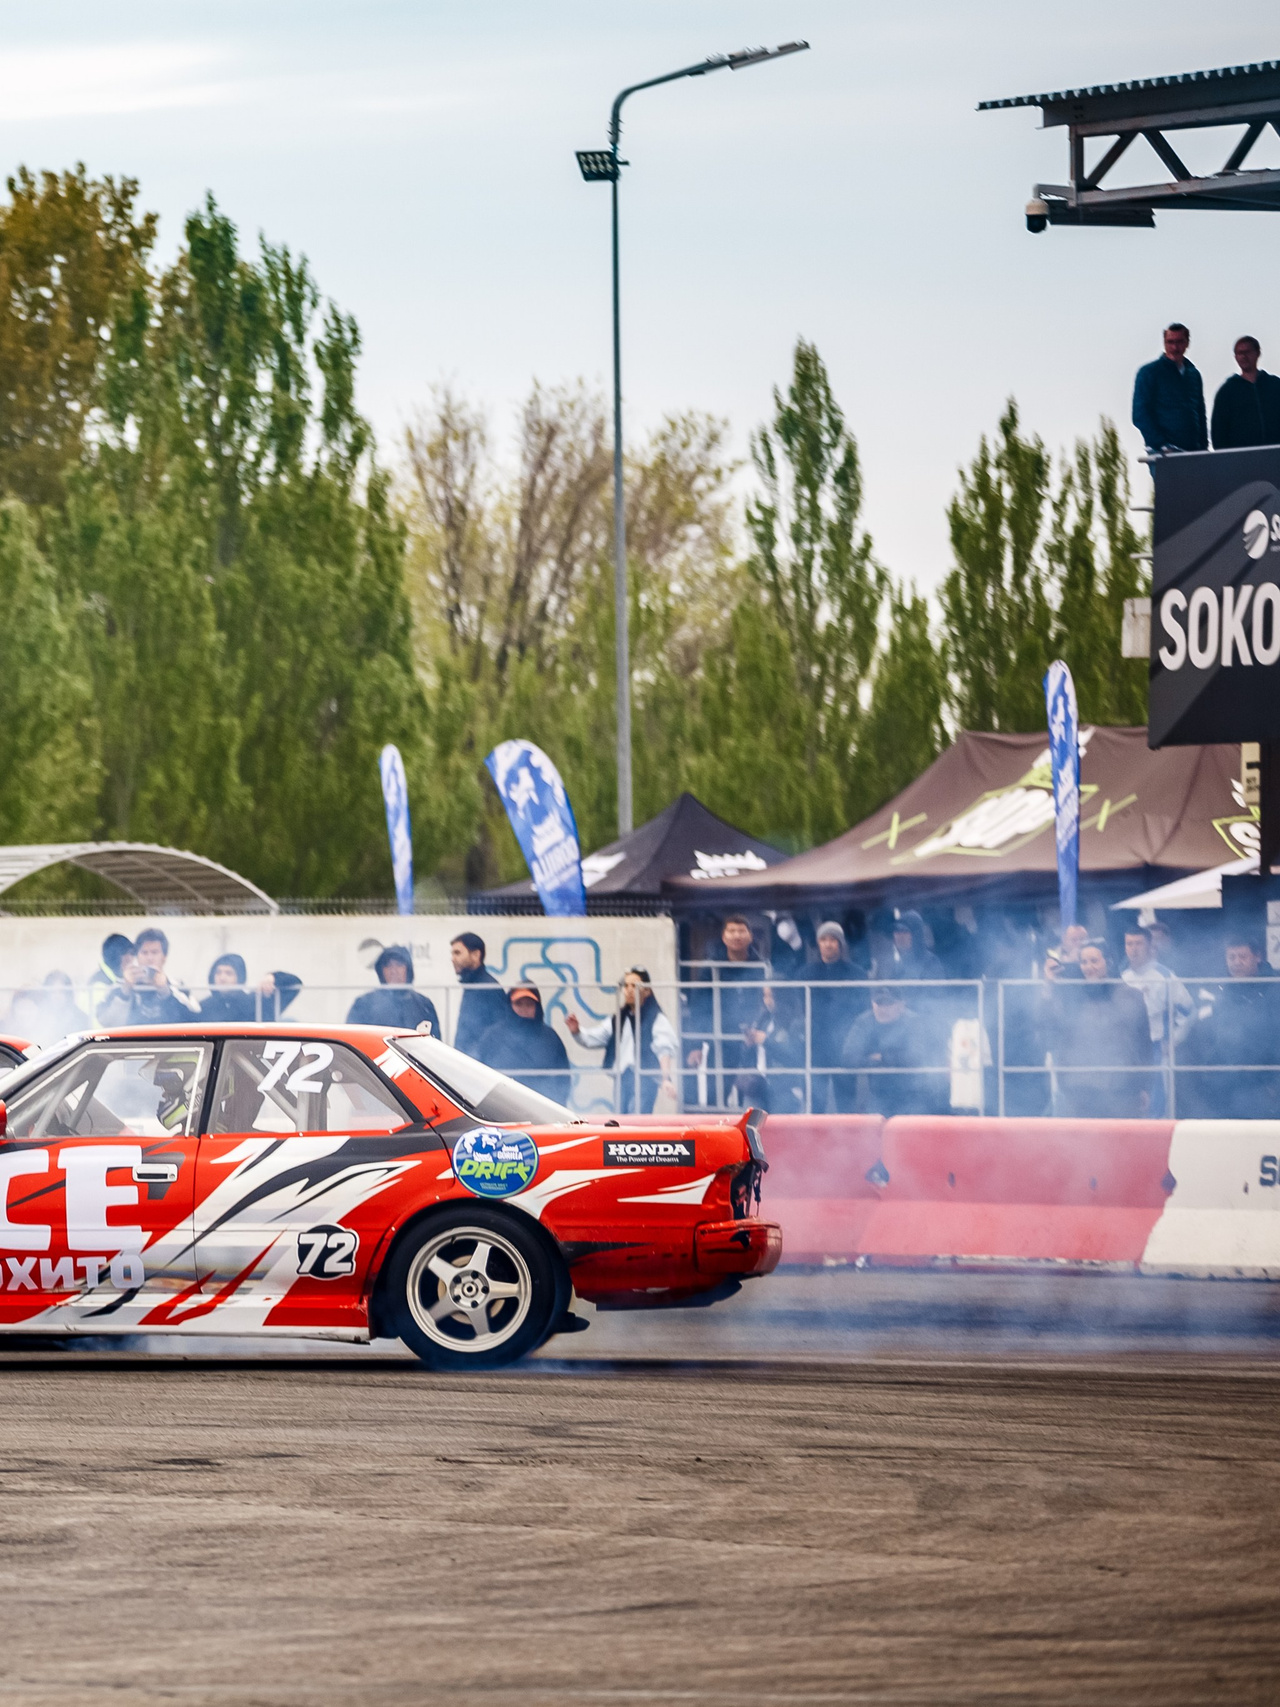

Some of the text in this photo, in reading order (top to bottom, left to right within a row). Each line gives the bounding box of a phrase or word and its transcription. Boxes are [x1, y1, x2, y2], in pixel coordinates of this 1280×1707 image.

[1158, 582, 1280, 671] SOKO
[257, 1041, 333, 1093] 72
[608, 1143, 691, 1156] HONDA
[1260, 1155, 1280, 1187] S
[299, 1232, 356, 1273] 72
